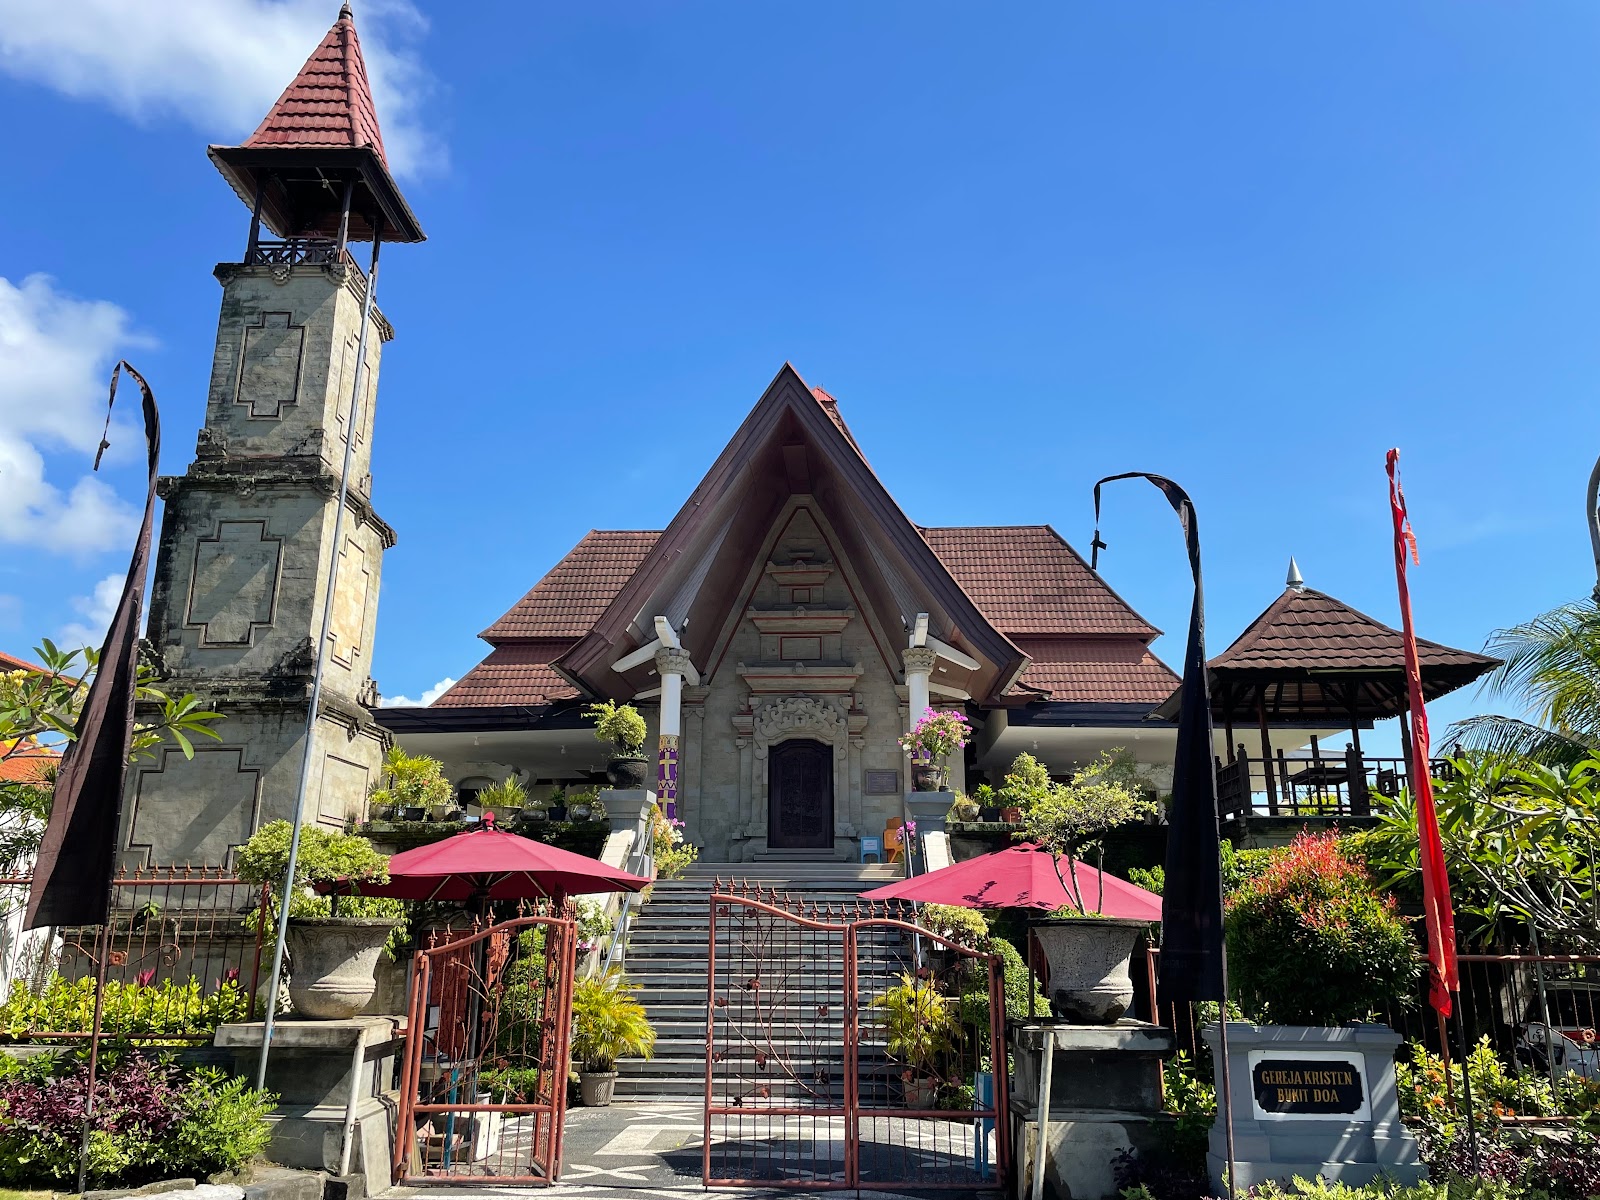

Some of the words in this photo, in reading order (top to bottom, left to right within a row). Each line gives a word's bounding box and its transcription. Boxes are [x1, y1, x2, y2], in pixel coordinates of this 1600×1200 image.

[1261, 1071, 1303, 1085] GEREJA
[1303, 1071, 1353, 1086] KRISTEN
[1277, 1088, 1308, 1103] BUKIT
[1313, 1088, 1340, 1102] DOA
